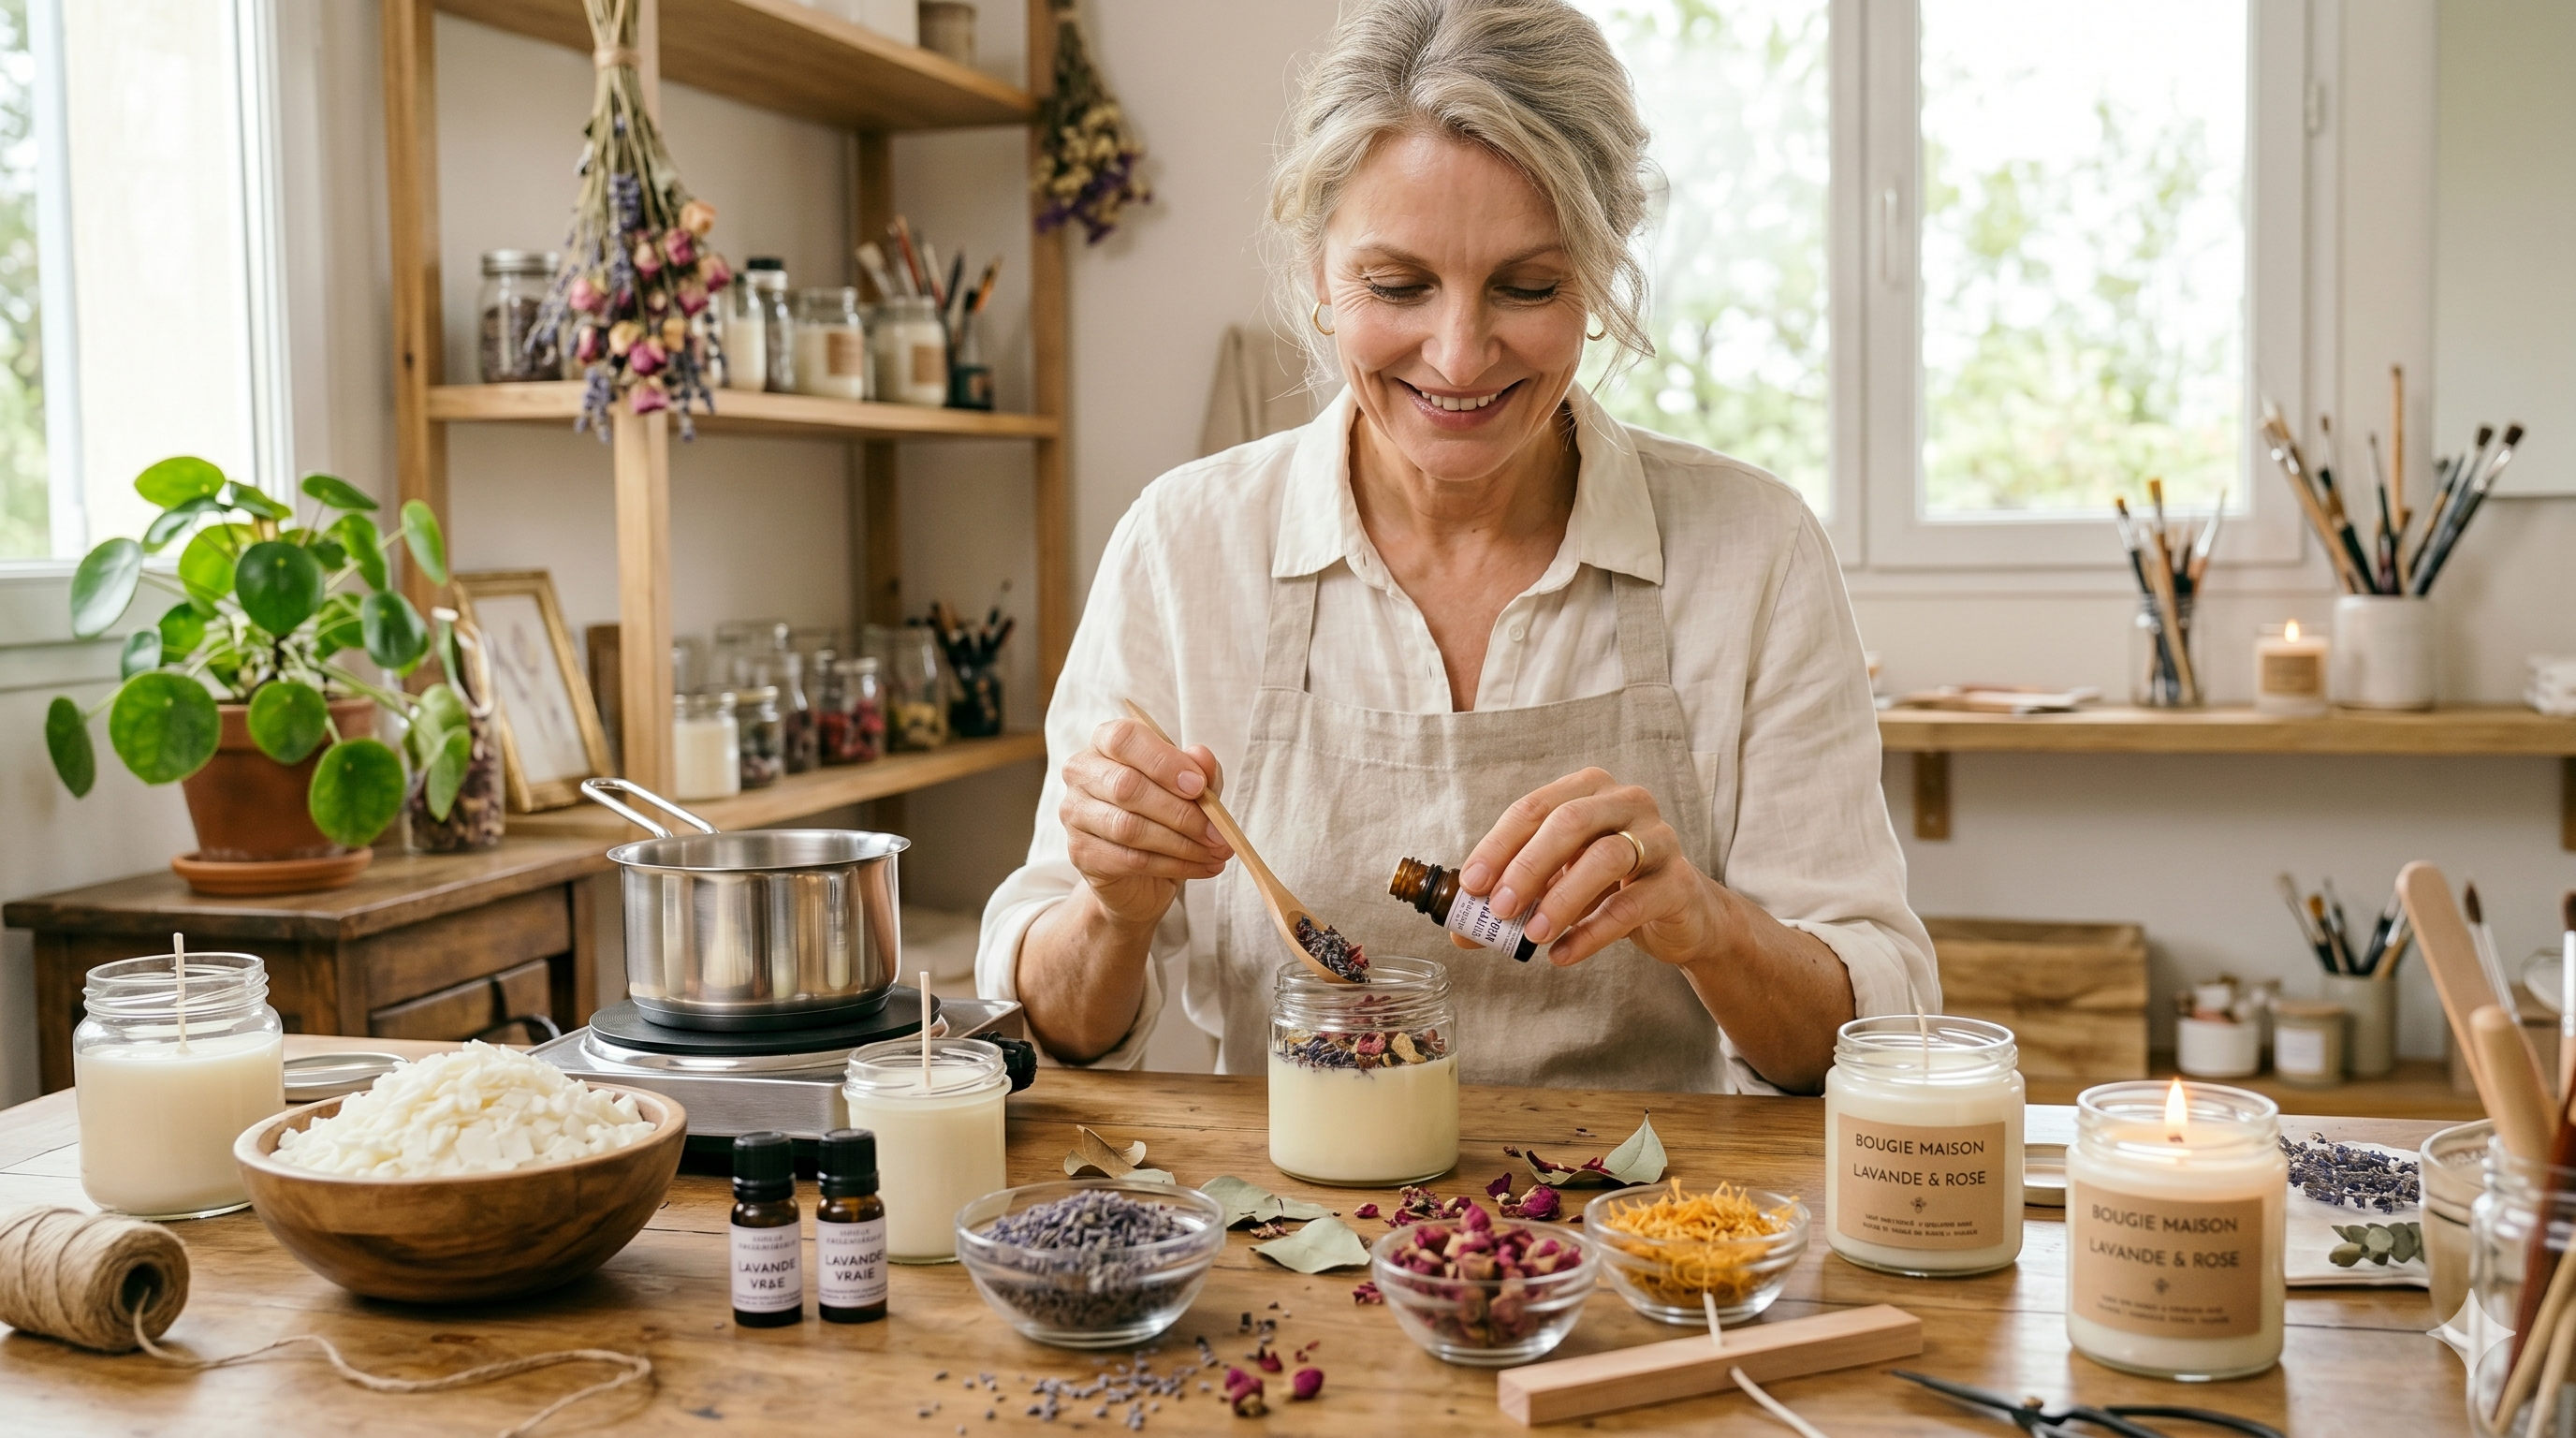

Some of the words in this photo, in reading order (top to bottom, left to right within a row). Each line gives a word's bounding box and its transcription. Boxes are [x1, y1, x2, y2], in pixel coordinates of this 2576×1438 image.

[1855, 1133, 1913, 1154] BOUGIE
[1920, 1140, 1984, 1155] MAISON
[1853, 1163, 1923, 1186] LAVANDE
[1928, 1172, 1939, 1186] &
[1946, 1170, 1986, 1186] ROSE
[2092, 1204, 2156, 1230] BOUGIE
[2162, 1217, 2238, 1234] MAISON
[826, 1249, 883, 1266] LAVANDE
[2089, 1238, 2166, 1266] LAVANDE
[2173, 1251, 2186, 1267] &
[2193, 1251, 2240, 1269] ROSE
[738, 1257, 796, 1273] LAVANDE
[835, 1268, 874, 1282] VRAIE
